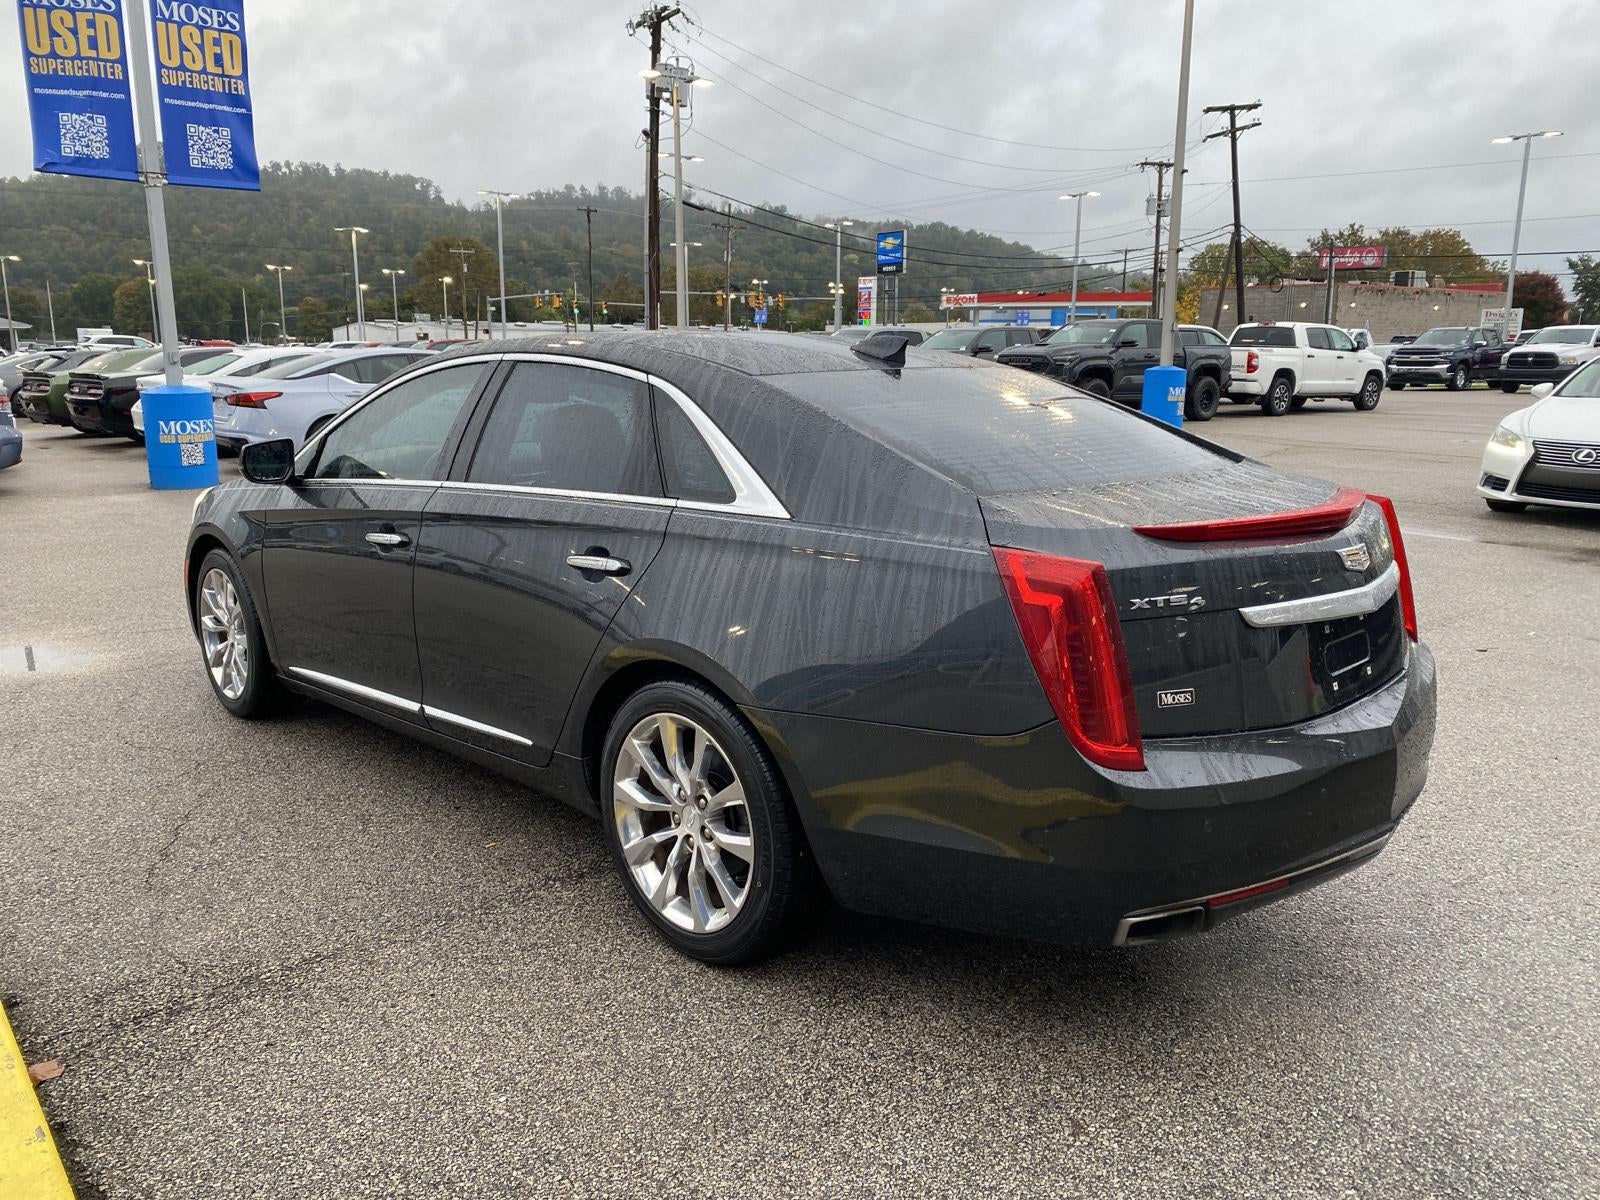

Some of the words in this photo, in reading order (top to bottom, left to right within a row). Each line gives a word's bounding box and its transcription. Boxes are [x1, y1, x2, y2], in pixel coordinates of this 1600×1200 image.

[156, 0, 240, 31] MOSES
[23, 7, 120, 59] USED
[156, 21, 242, 76] USED
[30, 57, 123, 80] SUPERCENTER
[161, 68, 245, 95] SUPERCENTER
[34, 87, 125, 100] mosesusedsupercenter.com
[164, 98, 247, 113] mosesusedsupercenter.com
[946, 295, 975, 306] EXXON
[158, 419, 214, 435] MOSES
[1161, 693, 1192, 705] MOSES
